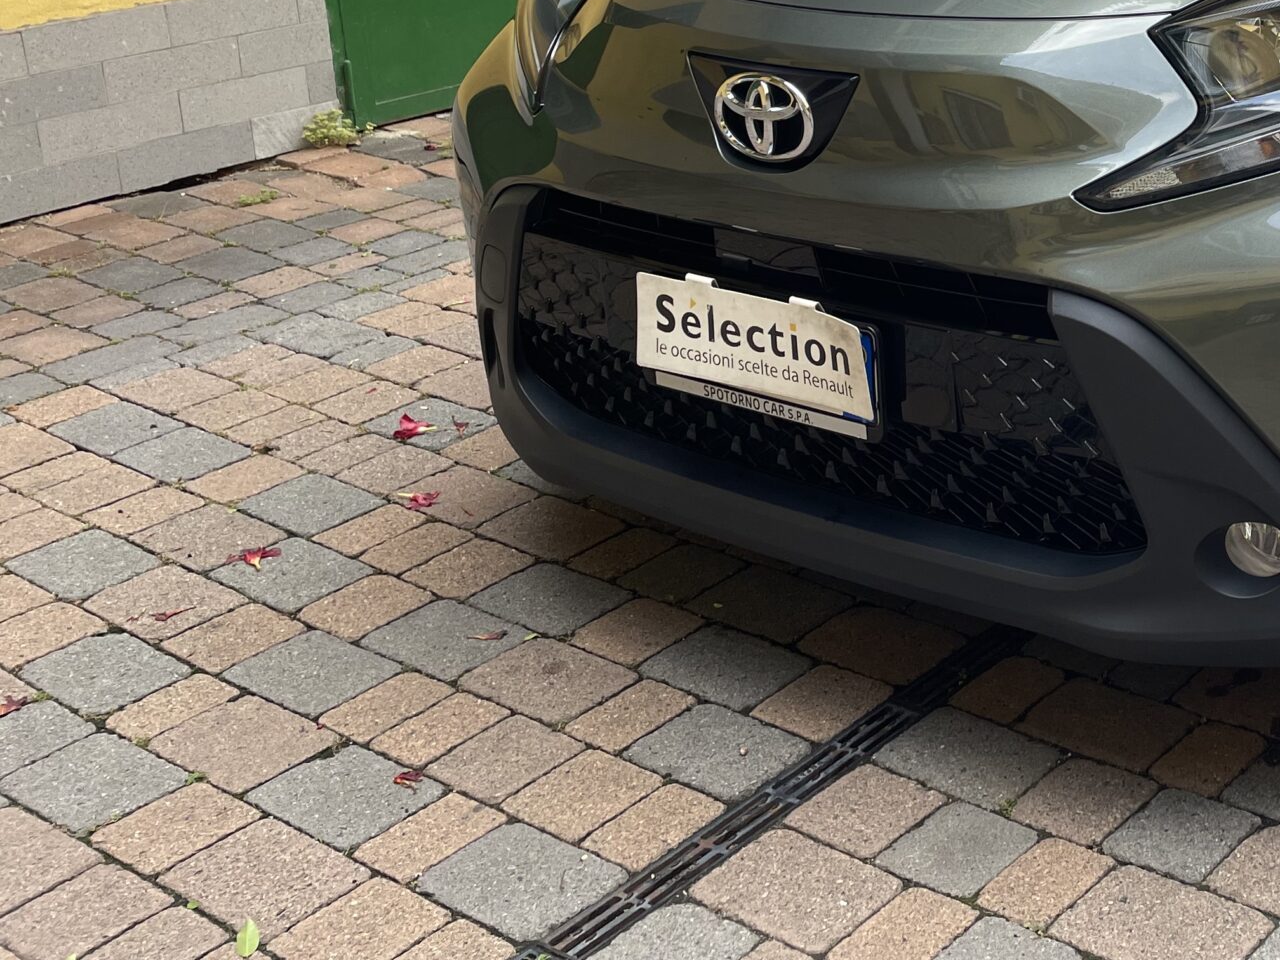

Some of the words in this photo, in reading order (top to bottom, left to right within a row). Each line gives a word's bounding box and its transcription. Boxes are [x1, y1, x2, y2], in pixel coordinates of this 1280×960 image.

[655, 338, 668, 357] le
[671, 343, 735, 369] occasioni
[738, 356, 778, 380] scelte
[781, 365, 800, 384] da
[803, 369, 854, 399] Renault
[703, 385, 761, 411] SPOTORNO
[763, 400, 786, 418] CAR
